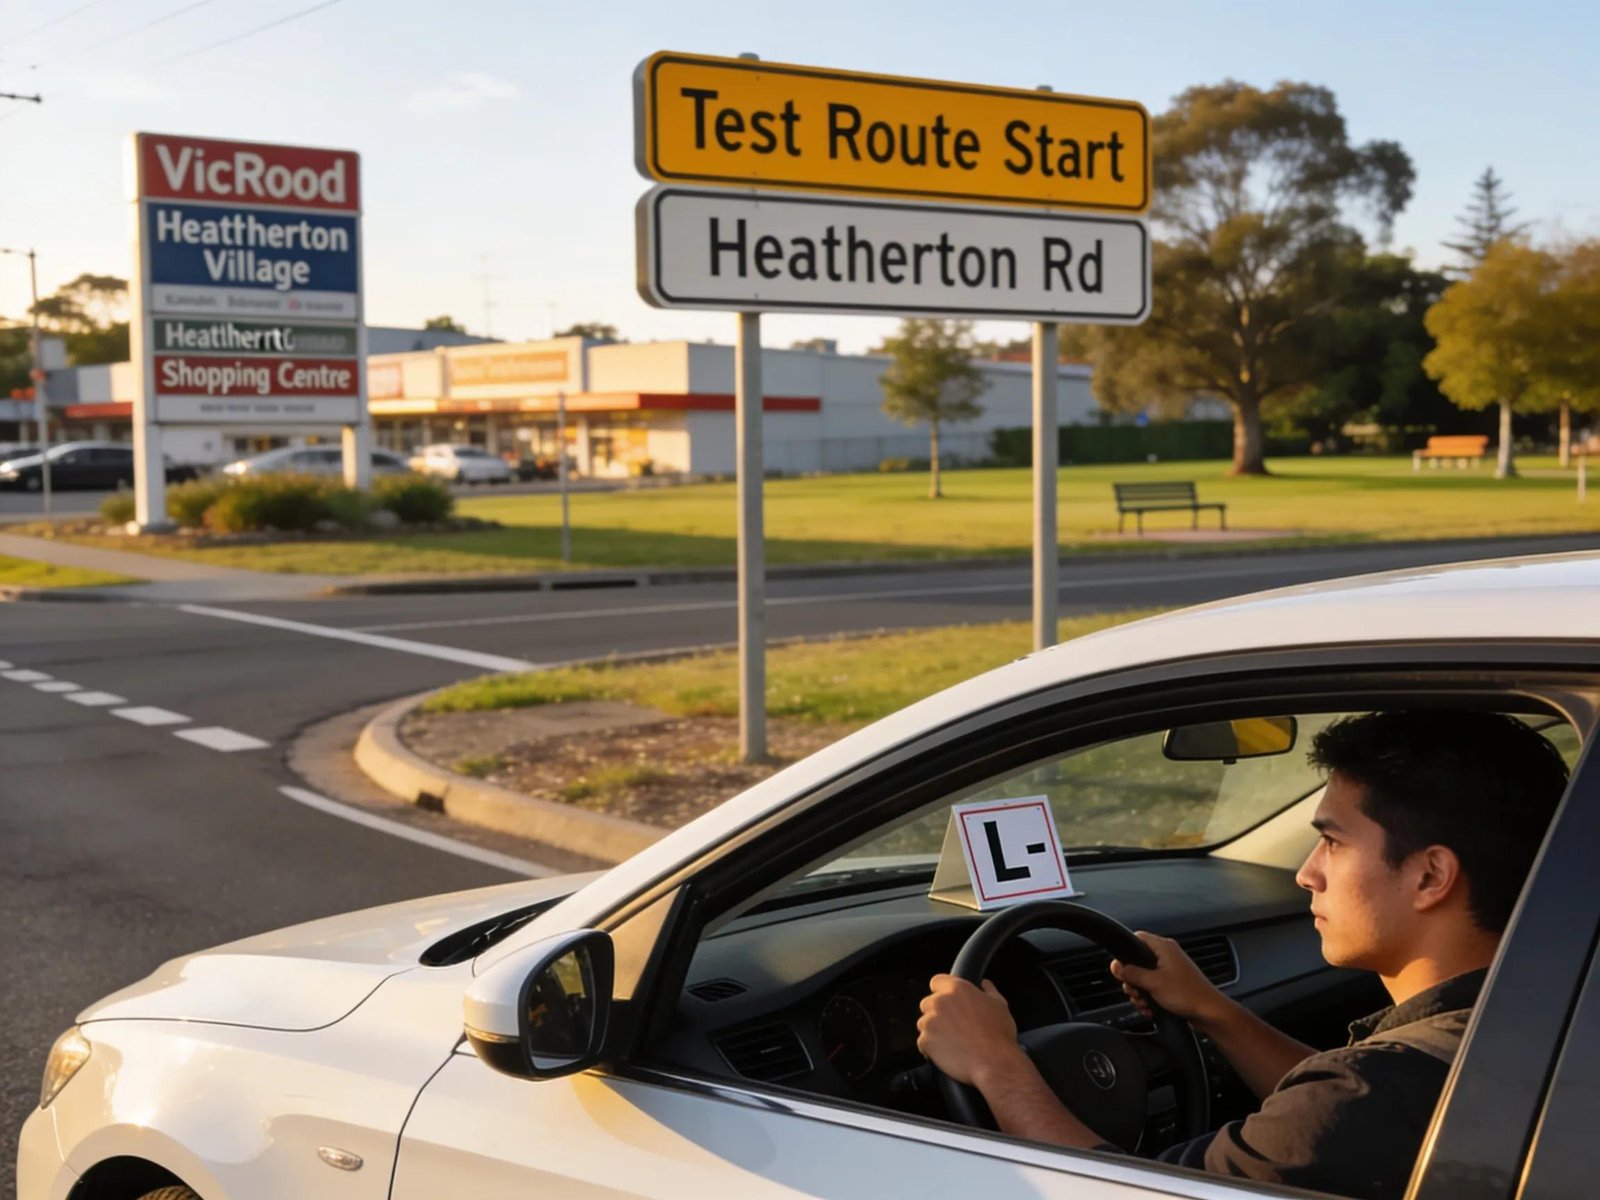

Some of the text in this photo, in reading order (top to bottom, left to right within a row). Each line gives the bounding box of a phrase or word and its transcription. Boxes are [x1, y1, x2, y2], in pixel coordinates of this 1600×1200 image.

[681, 87, 1125, 182] Test Route Start
[155, 144, 347, 203] VicRood
[203, 248, 311, 290] Village
[708, 217, 1104, 294] Heatherton Rd
[162, 359, 351, 395] Shopping Centre
